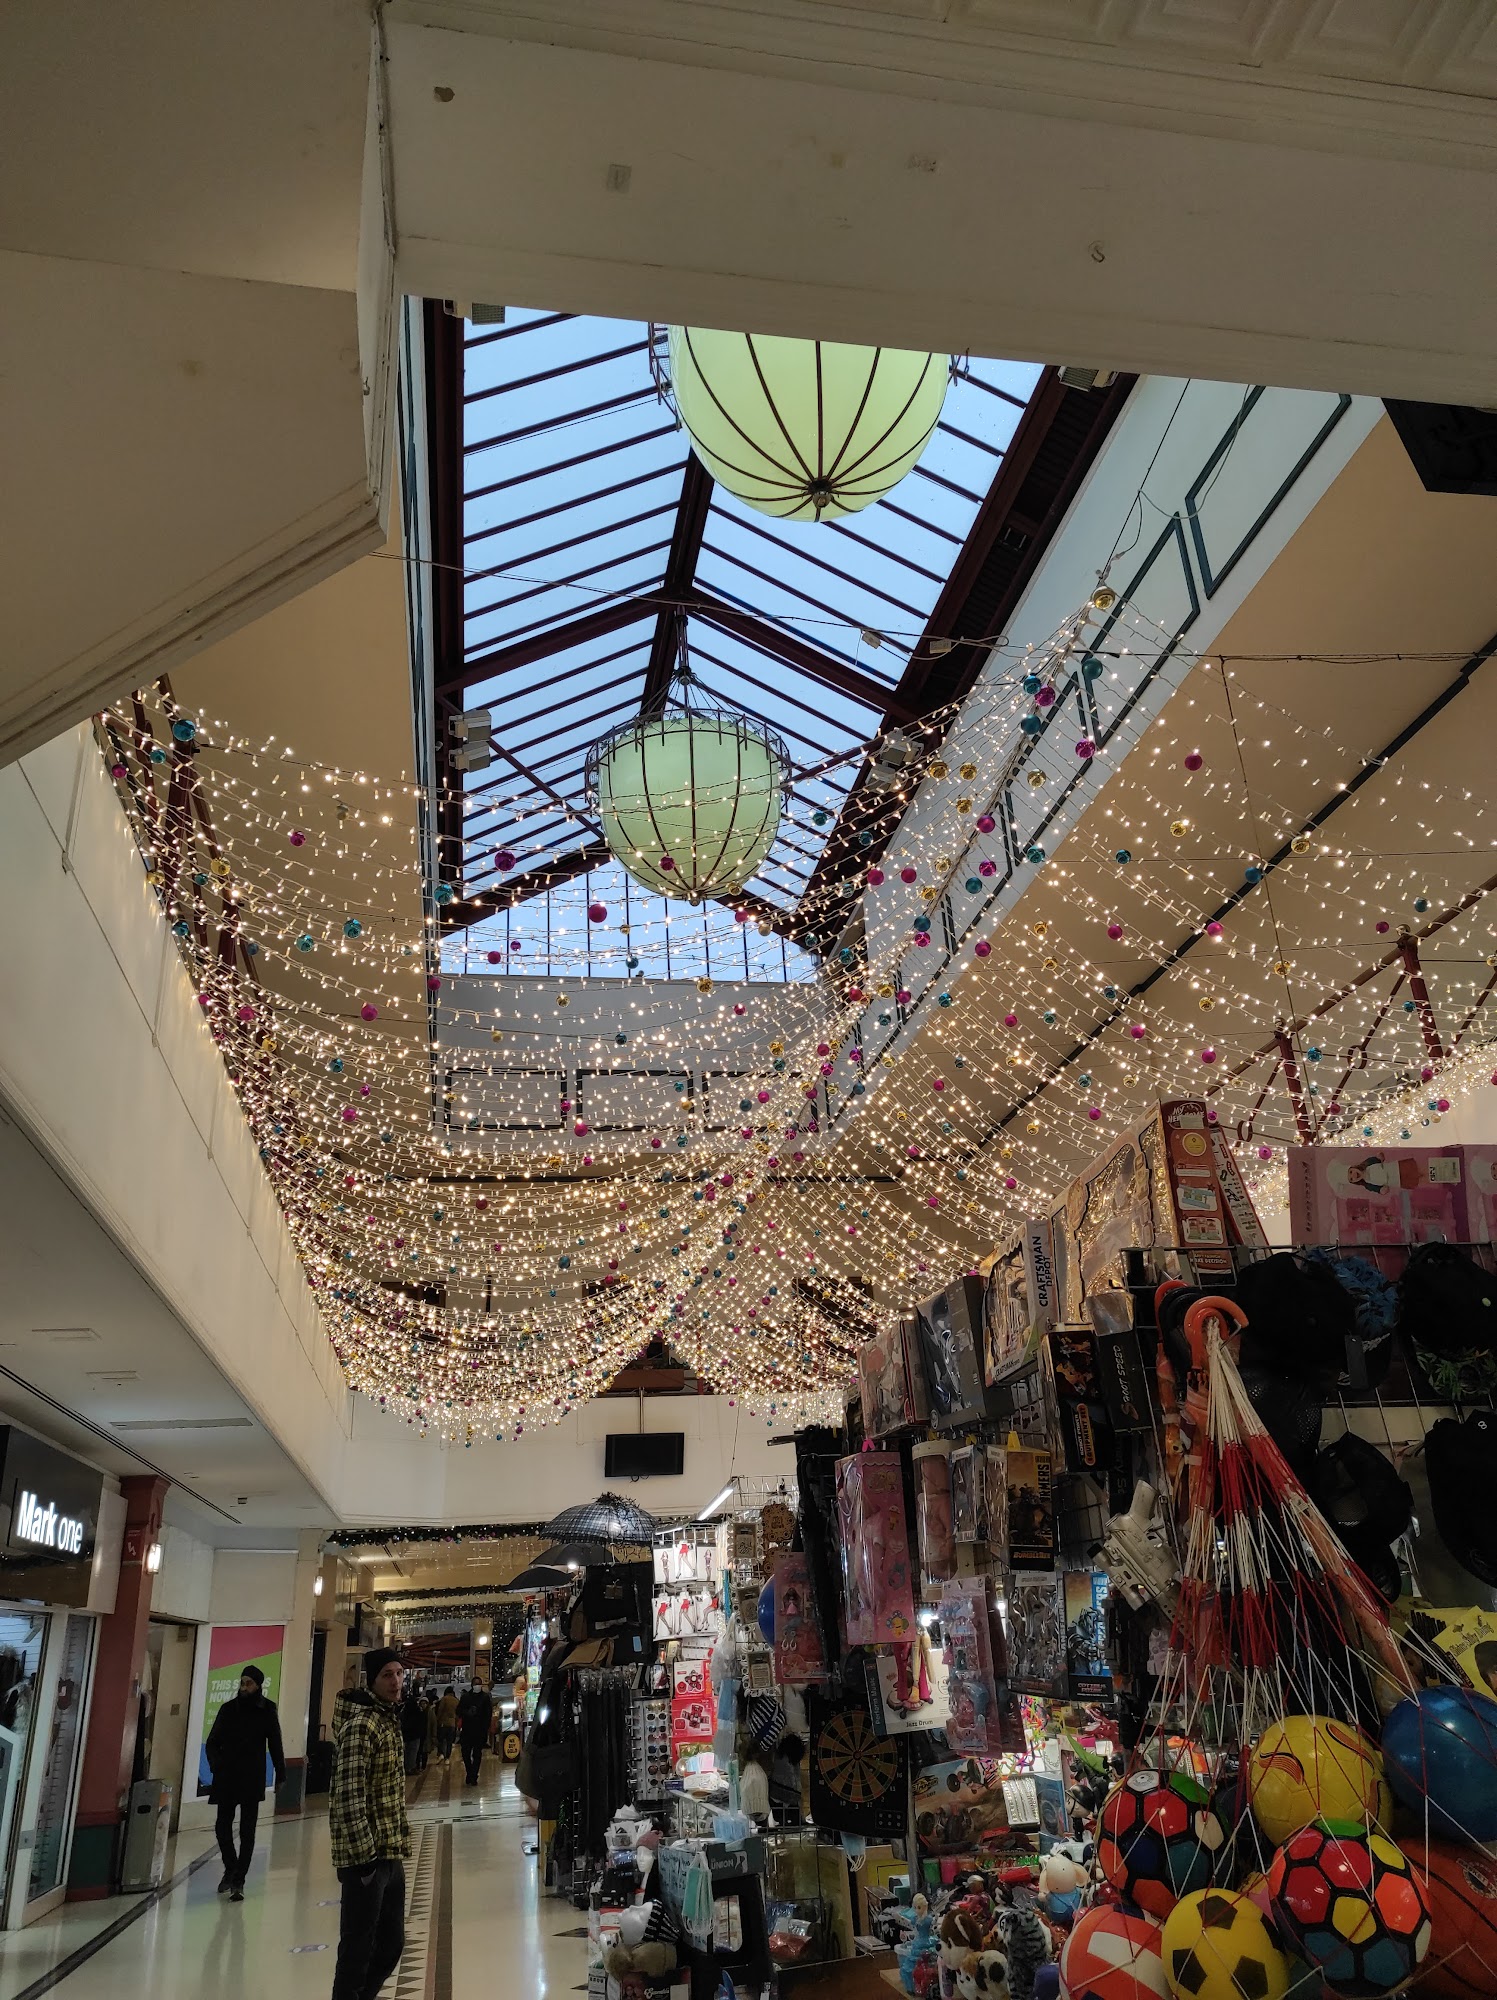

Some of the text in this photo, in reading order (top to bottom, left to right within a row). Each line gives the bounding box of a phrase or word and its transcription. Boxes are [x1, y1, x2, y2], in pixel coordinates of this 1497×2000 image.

[1032, 1236, 1049, 1307] CRAFTSMAN
[1044, 1256, 1053, 1287] DEPOT
[1112, 1344, 1126, 1377] SPEED
[1082, 1419, 1094, 1462] EQUIPMENT
[17, 1490, 83, 1554] Mark one
[209, 1690, 231, 1703] NOW
[211, 1680, 232, 1691] THIS
[869, 1677, 881, 1725] Perform Music
[906, 1719, 934, 1728] Jazz Drum
